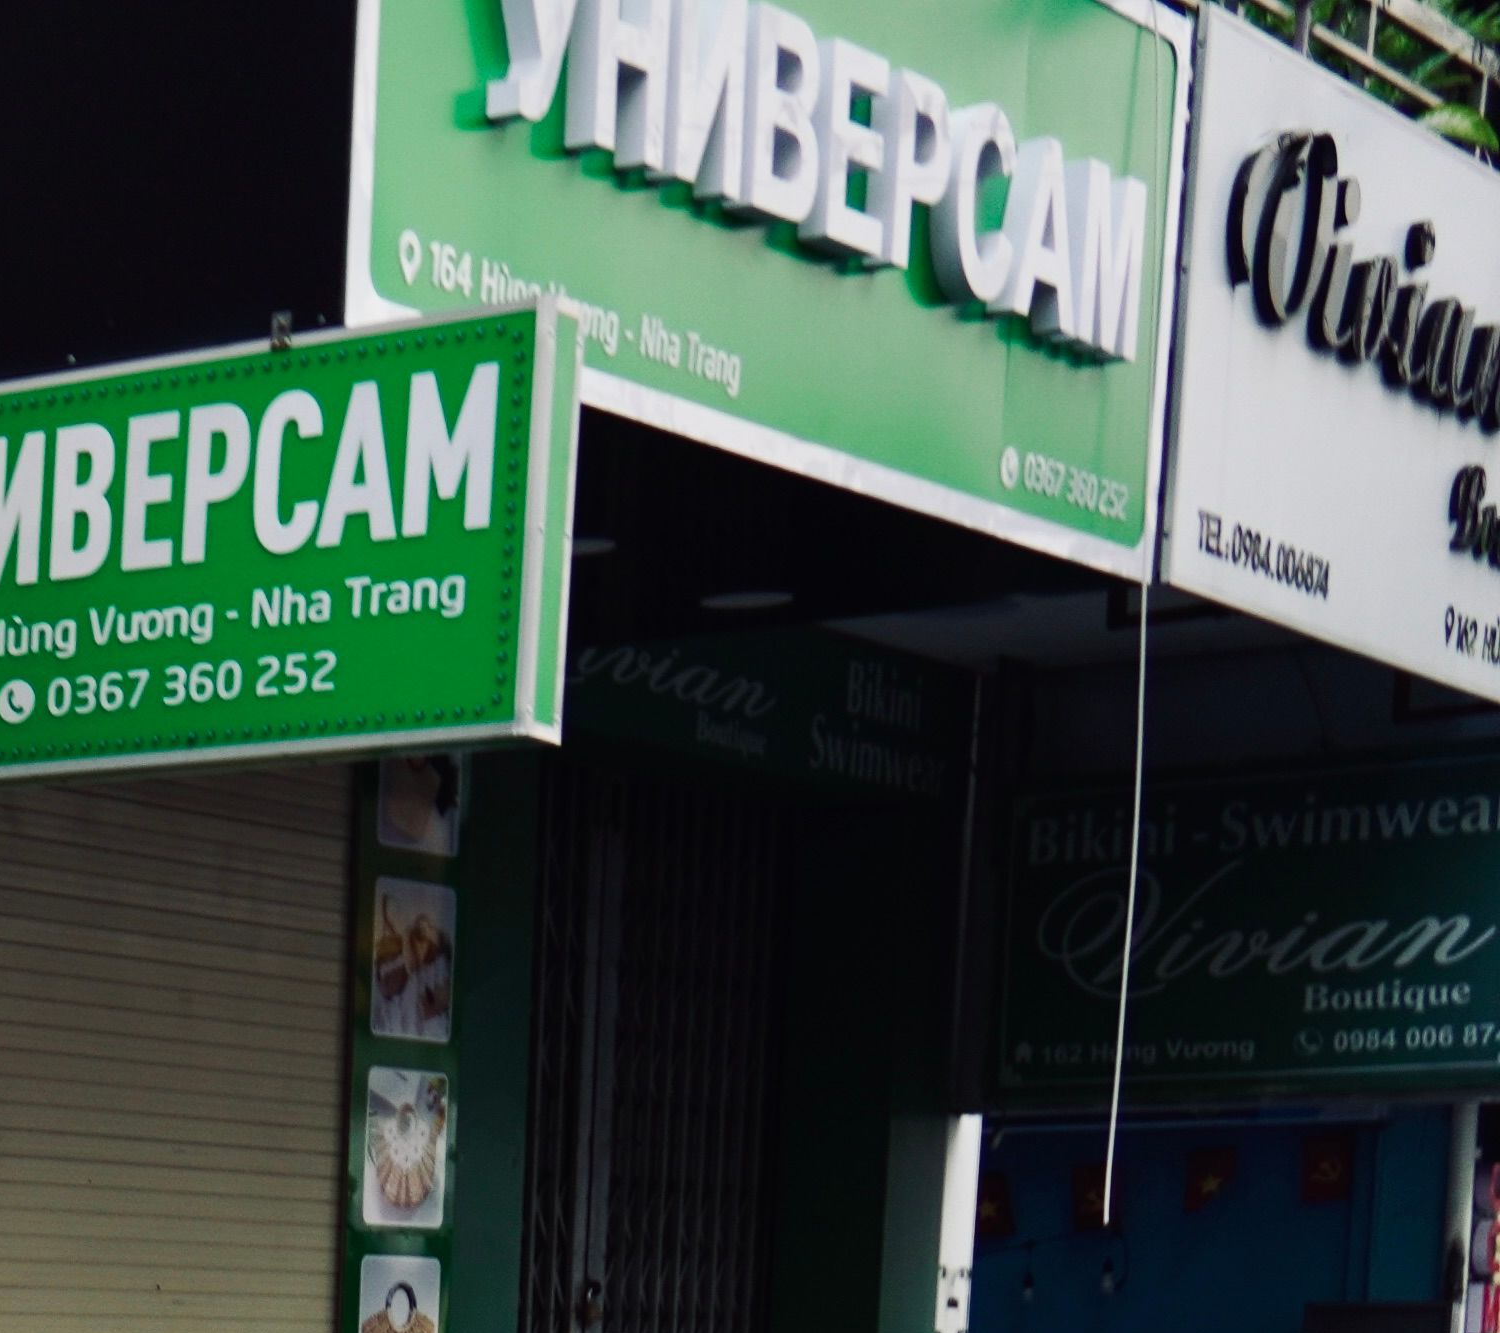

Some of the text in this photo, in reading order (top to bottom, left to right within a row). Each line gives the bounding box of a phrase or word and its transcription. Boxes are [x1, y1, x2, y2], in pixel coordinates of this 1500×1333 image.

[430, 240, 472, 297] 164
[639, 313, 682, 368] Nha
[685, 330, 742, 399] Trang
[1023, 452, 1129, 521] 0367 360 252
[89, 600, 215, 648] Vương
[251, 586, 331, 628] Nha
[344, 573, 467, 618] Trang
[46, 650, 338, 720] 0367 360 252
[845, 659, 924, 732] Bikini
[1219, 790, 1500, 855] Swimwea
[1037, 855, 1497, 1000] Vivian
[1302, 979, 1472, 1014] Boutique
[1333, 1026, 1397, 1053] 0984
[1404, 1024, 1454, 1051] 006
